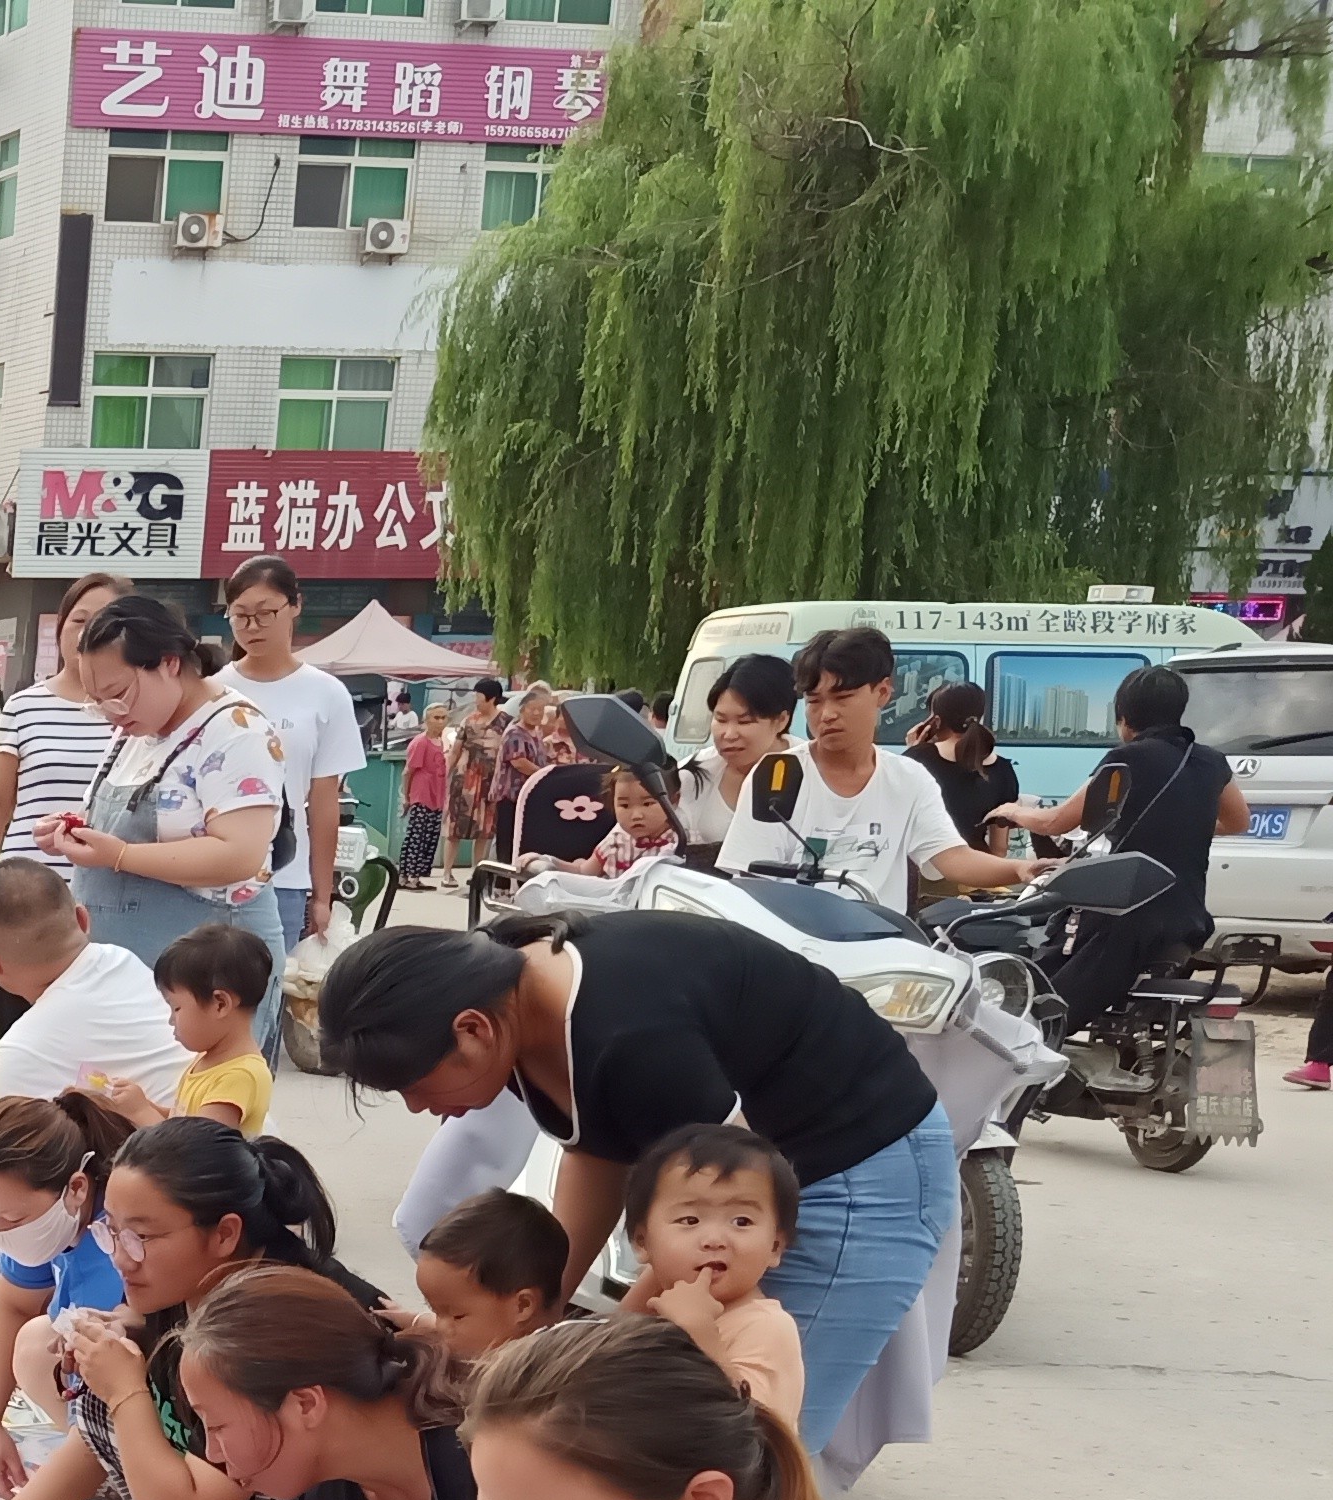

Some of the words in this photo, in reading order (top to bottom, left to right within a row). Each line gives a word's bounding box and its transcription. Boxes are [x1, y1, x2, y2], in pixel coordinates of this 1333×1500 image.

[99, 40, 267, 122] 艺迪
[319, 57, 443, 118] 舞蹈
[484, 65, 602, 122] 钢琴
[40, 470, 185, 521] M&G
[36, 522, 179, 557] 晨光文具
[1037, 610, 1197, 635] 全龄段学府家
